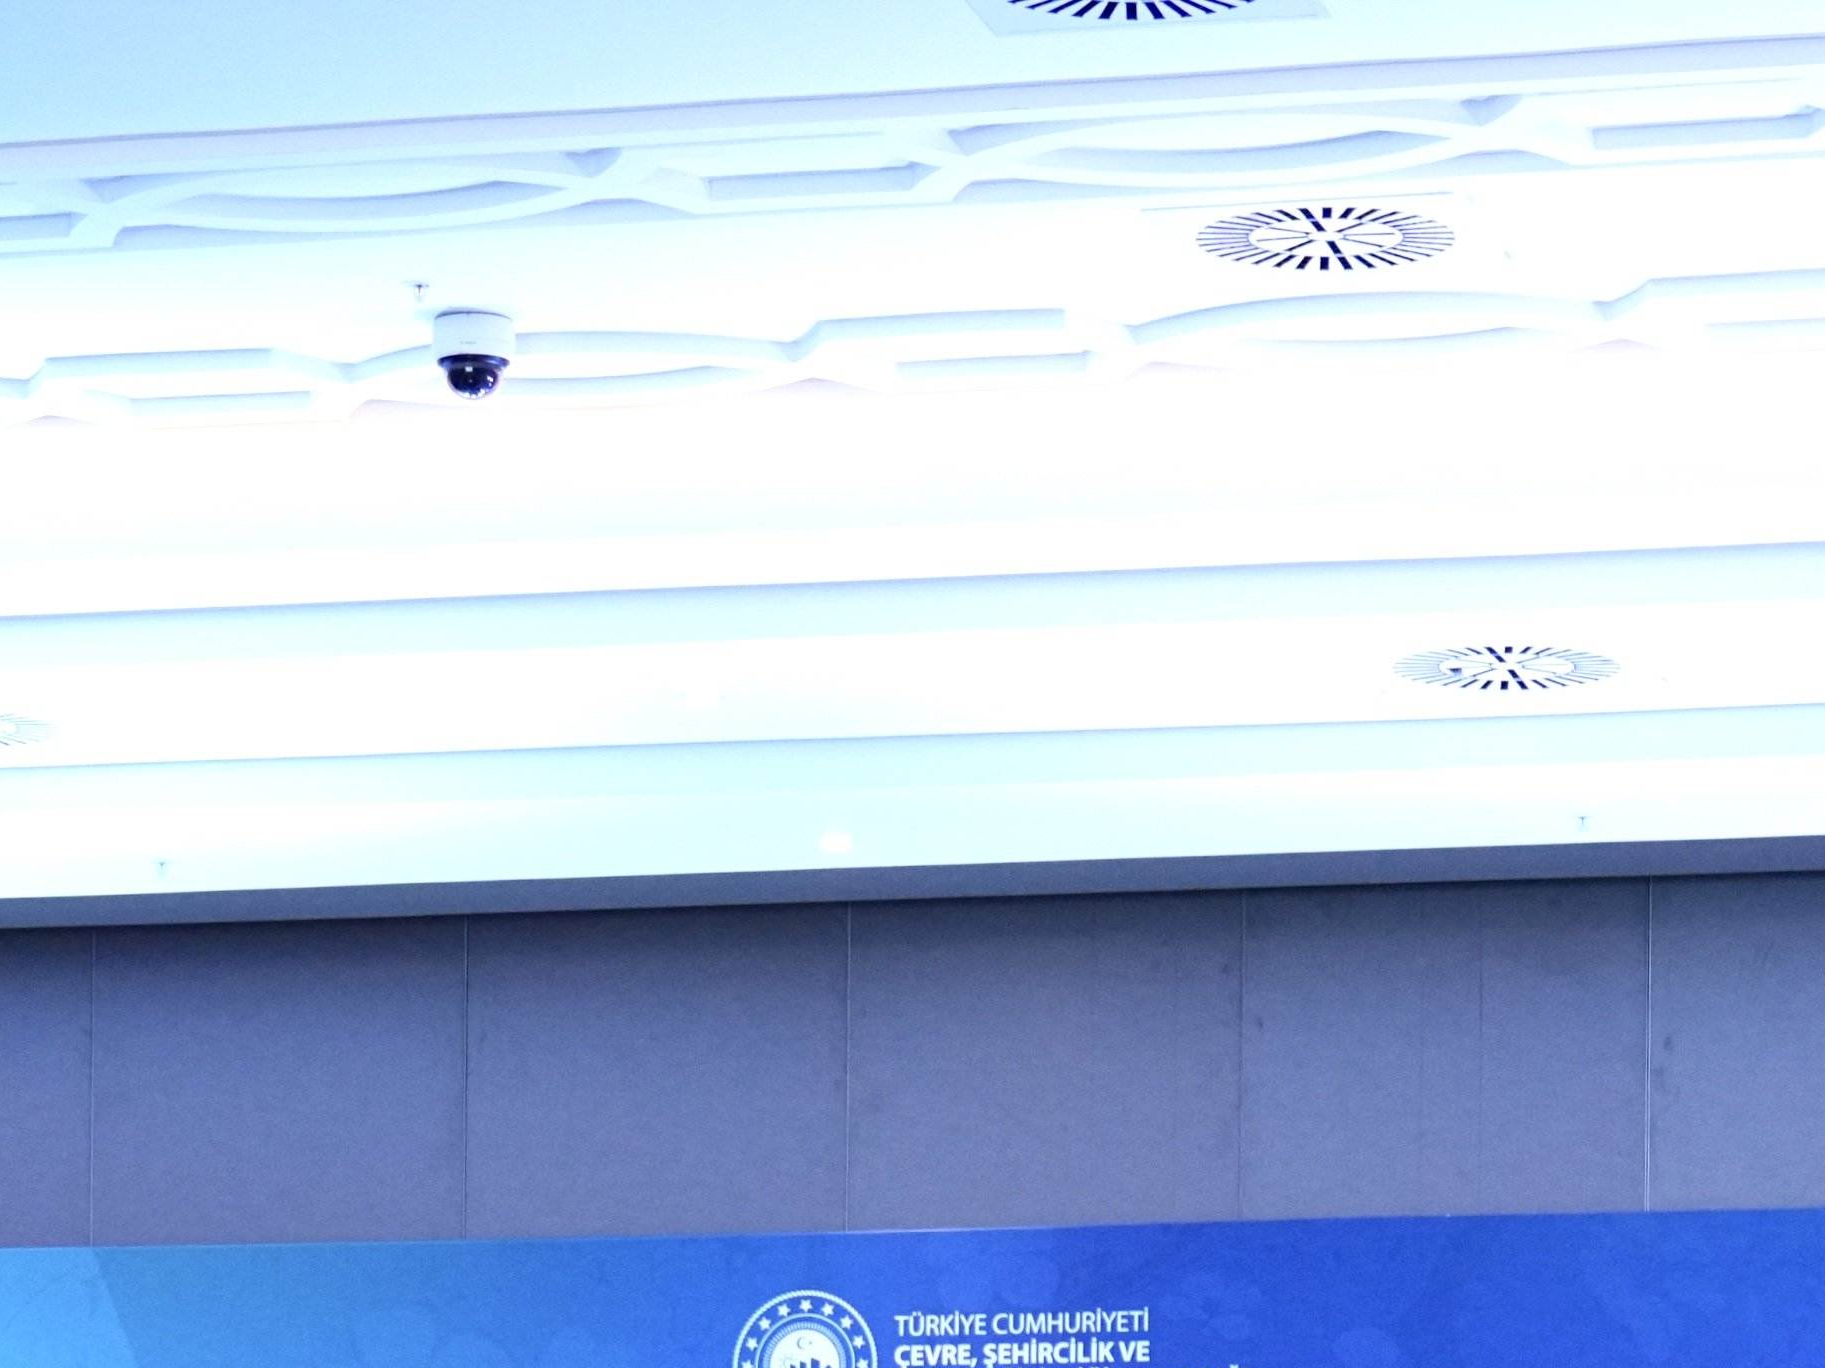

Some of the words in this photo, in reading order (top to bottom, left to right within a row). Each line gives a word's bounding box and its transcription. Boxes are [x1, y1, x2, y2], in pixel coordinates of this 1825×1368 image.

[894, 1311, 987, 1336] TÜRKİYE
[991, 1307, 1150, 1335] CUMHURİYETİ
[1119, 1341, 1151, 1363] VE
